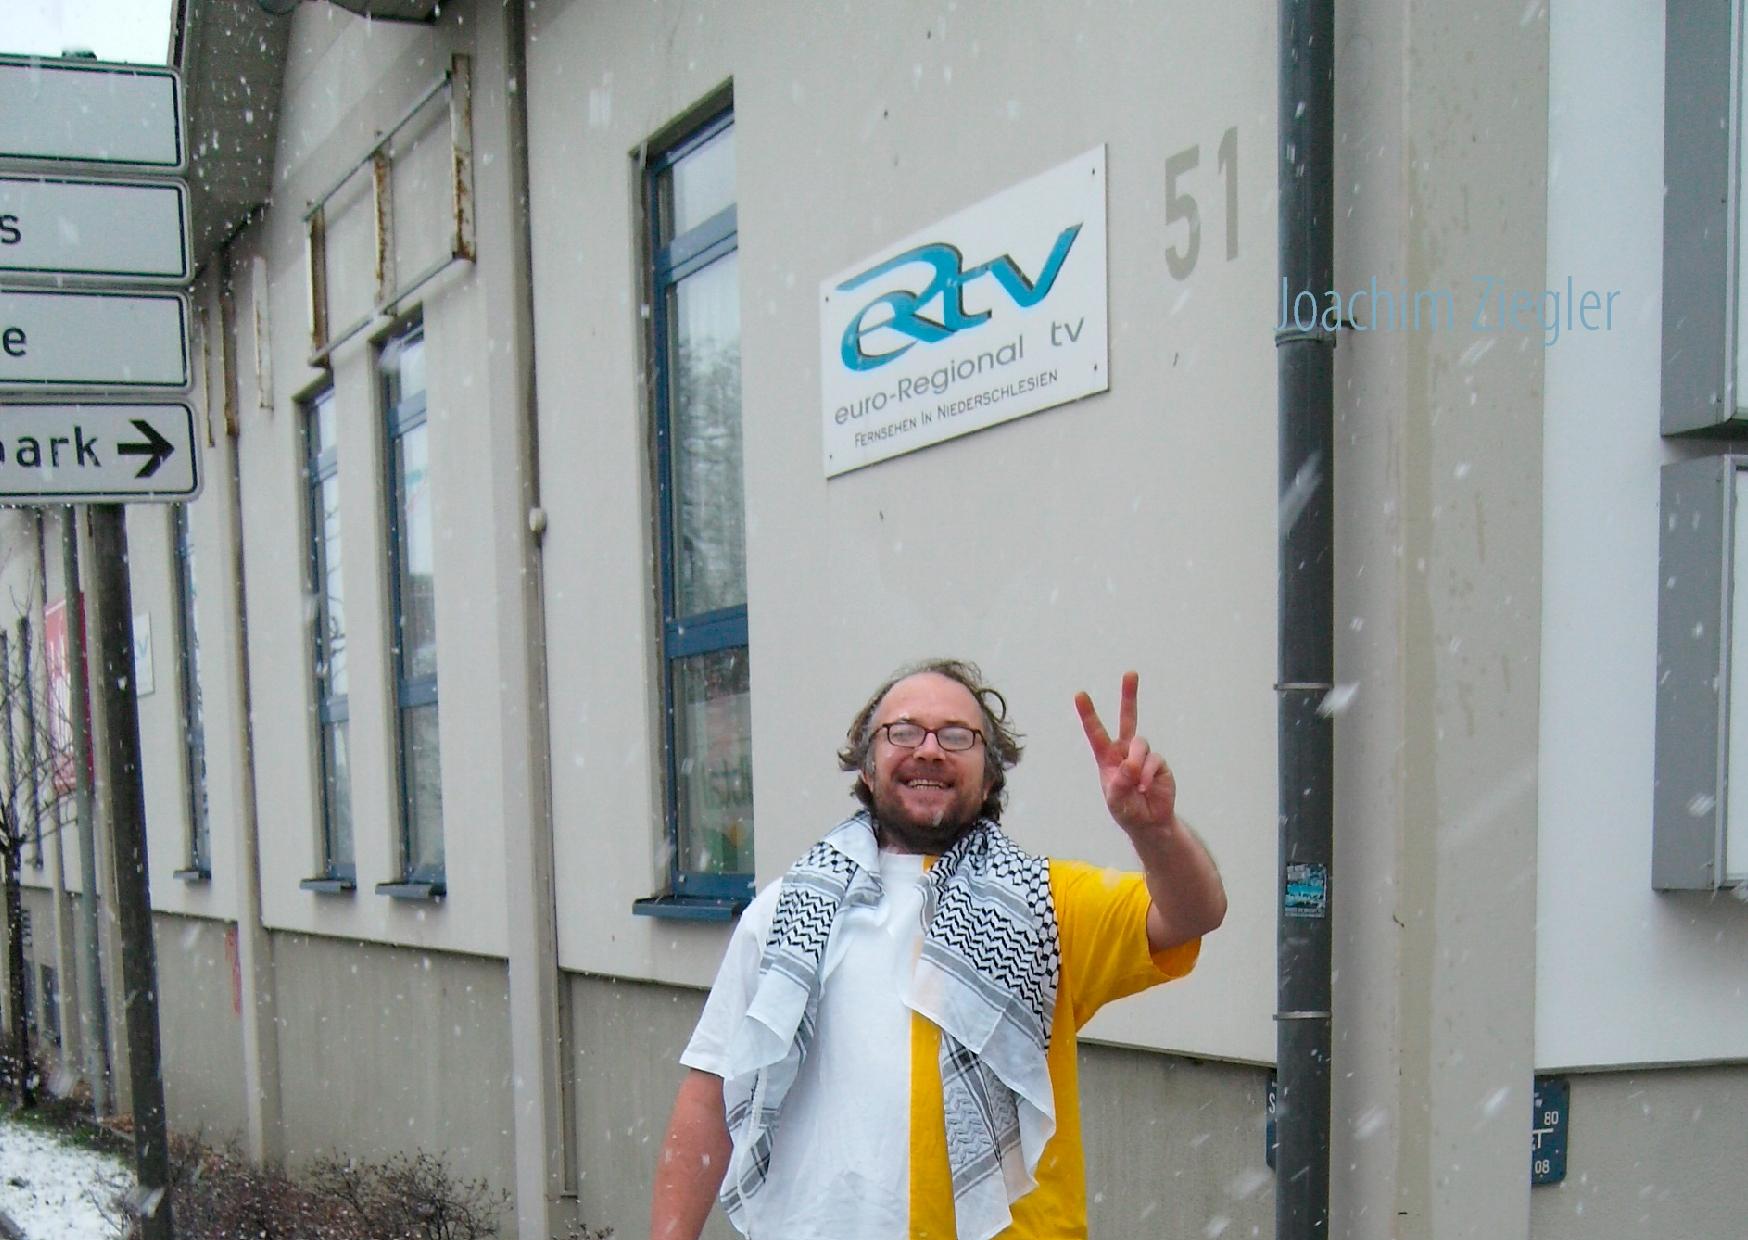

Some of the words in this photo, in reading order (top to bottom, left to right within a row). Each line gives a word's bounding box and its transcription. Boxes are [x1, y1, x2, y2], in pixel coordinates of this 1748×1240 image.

[1165, 125, 1239, 281] 51
[834, 334, 1024, 425] euro-Regional
[1050, 316, 1085, 347] tv
[937, 368, 1059, 419] NIEDERSCHLESIEN
[0, 425, 102, 467] ark
